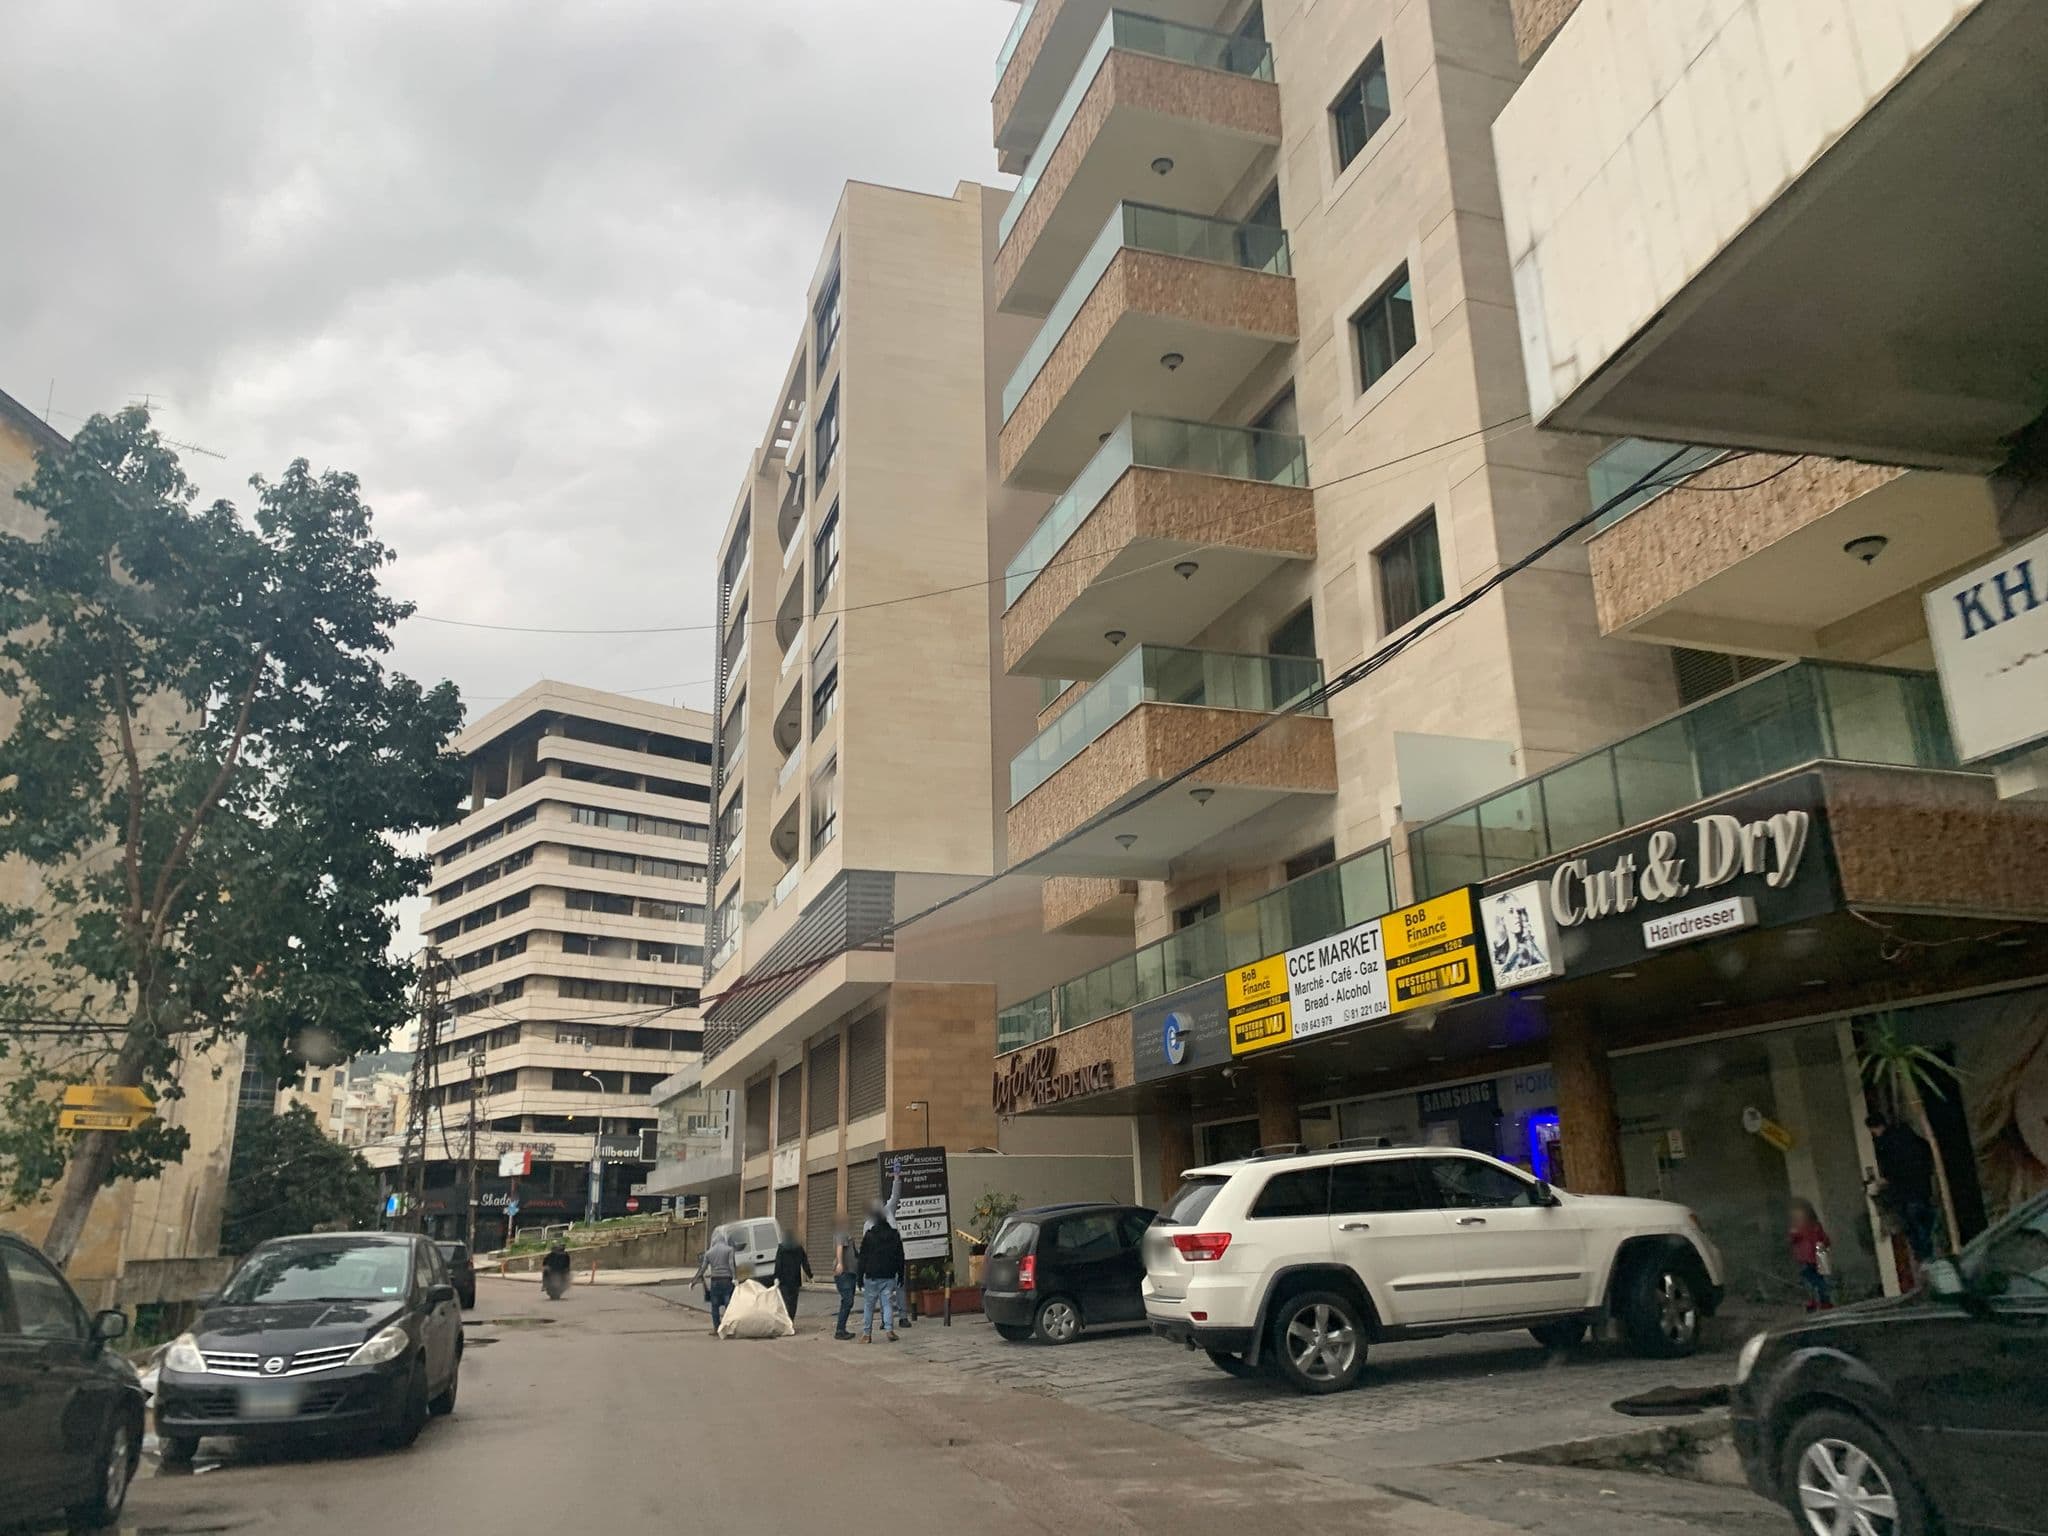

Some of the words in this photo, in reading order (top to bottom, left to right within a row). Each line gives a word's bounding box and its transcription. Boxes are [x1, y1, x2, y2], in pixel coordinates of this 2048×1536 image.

[1953, 558, 2048, 641] KH
[1551, 853, 1638, 927] Cut
[1640, 830, 1690, 903] &
[1693, 809, 1809, 889] Dry
[1405, 909, 1426, 926] BoB
[1648, 904, 1737, 944] Hairdresser
[1407, 920, 1447, 942] Finance
[1289, 951, 1316, 978] CCE
[1318, 929, 1379, 968] MARKET
[1242, 969, 1256, 982] BoB
[1294, 976, 1324, 996] Marché
[1331, 966, 1352, 984] Café
[1360, 960, 1378, 975] Gaz
[1398, 969, 1437, 989] WESTERN
[1243, 979, 1270, 995] Finance
[1304, 994, 1329, 1012] Bread
[1336, 981, 1371, 1003] Alcohol
[1410, 980, 1438, 995] UNION
[1360, 1004, 1372, 1017] 221
[1374, 1001, 1387, 1013] 034
[1036, 1059, 1114, 1105] RESIDENCE
[1422, 1082, 1490, 1112] SAMSUNG
[915, 1198, 940, 1206] MARKET
[913, 1222, 922, 1230] &
[924, 1220, 942, 1230] Dry
